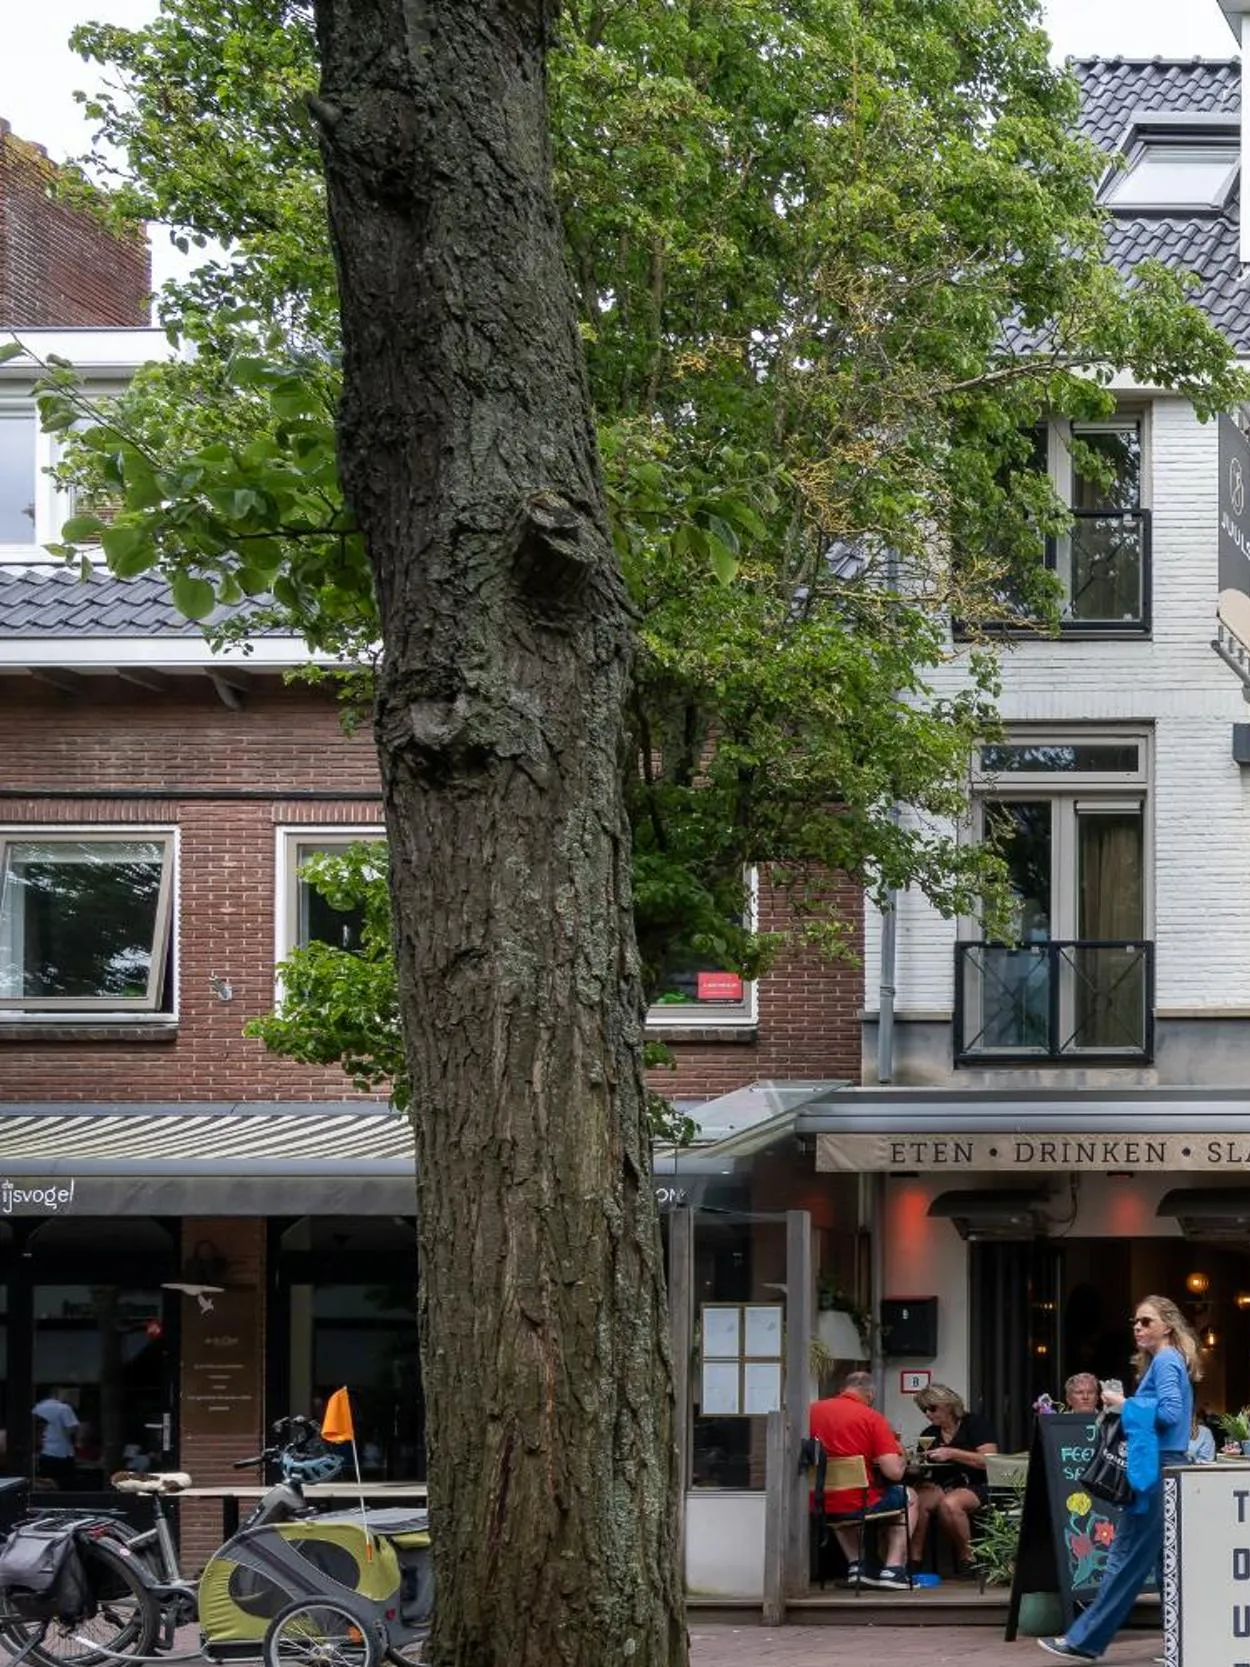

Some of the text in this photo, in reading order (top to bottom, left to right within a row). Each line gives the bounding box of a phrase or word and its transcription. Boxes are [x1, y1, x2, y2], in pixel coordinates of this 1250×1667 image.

[890, 1142, 974, 1163] ETEN
[1014, 1142, 1167, 1163] DRINKEN
[2, 1177, 74, 1213] ijsvogel
[1233, 1490, 1250, 1667] TOU
